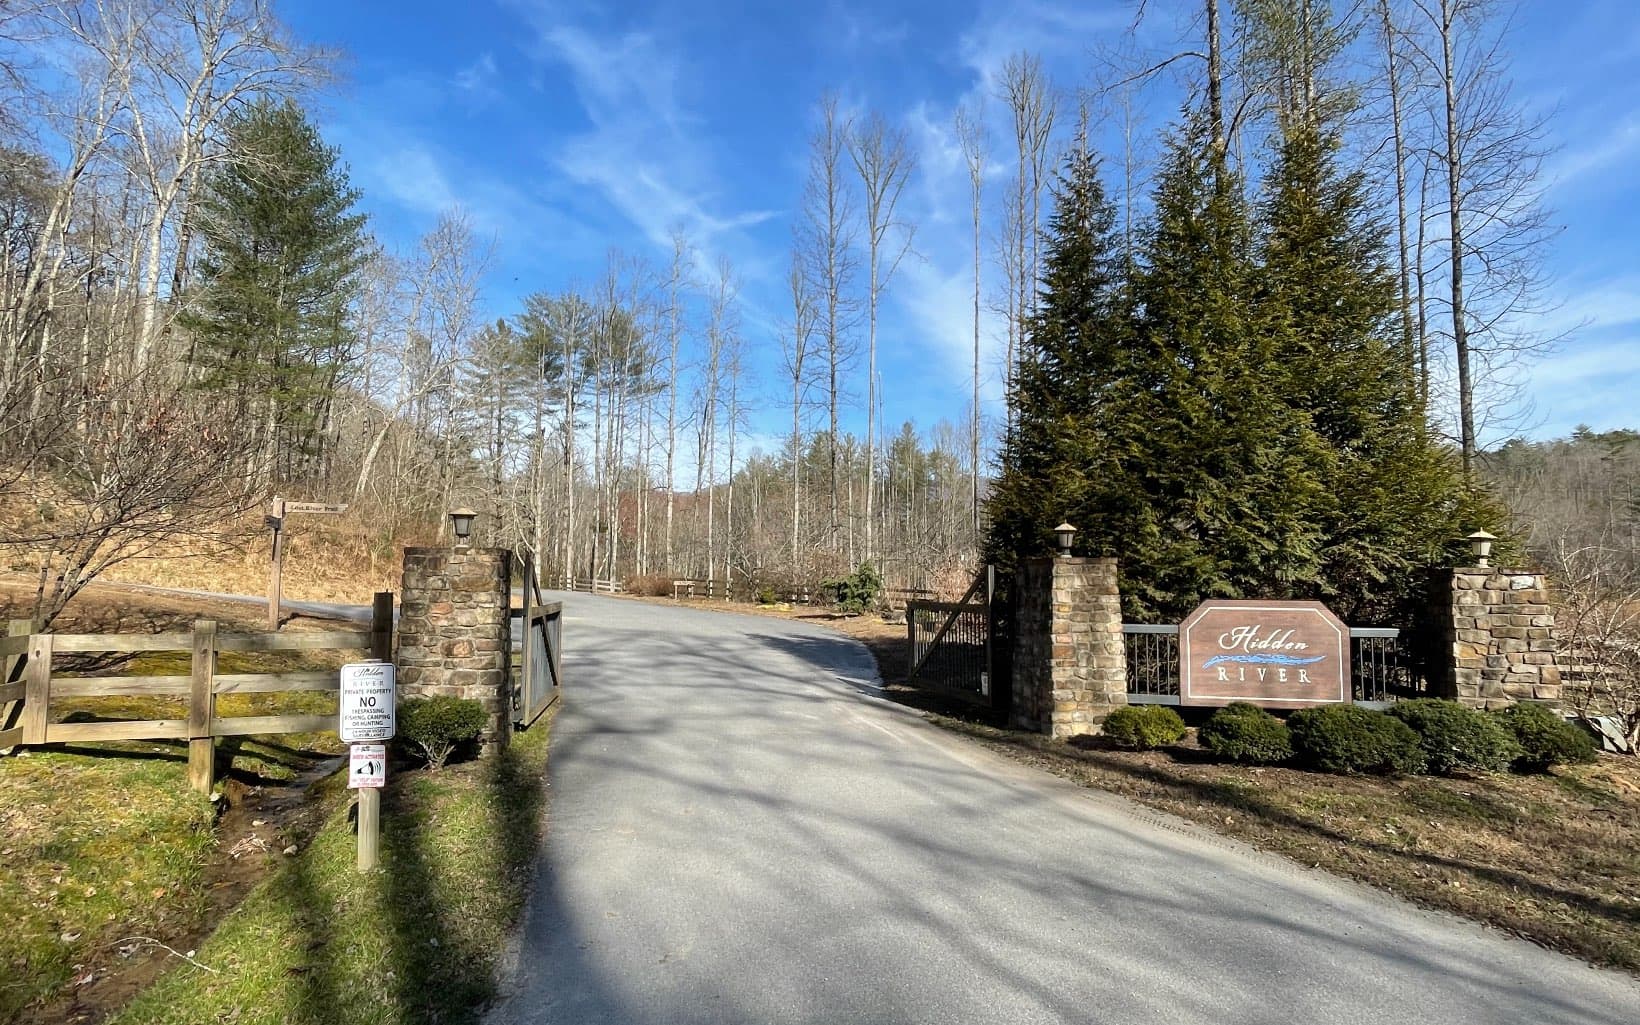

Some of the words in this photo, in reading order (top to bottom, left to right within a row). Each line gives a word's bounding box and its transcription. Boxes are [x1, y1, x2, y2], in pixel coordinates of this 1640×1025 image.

[1218, 625, 1308, 653] Hidden
[1218, 667, 1311, 683] RIVER
[360, 696, 376, 707] NO
